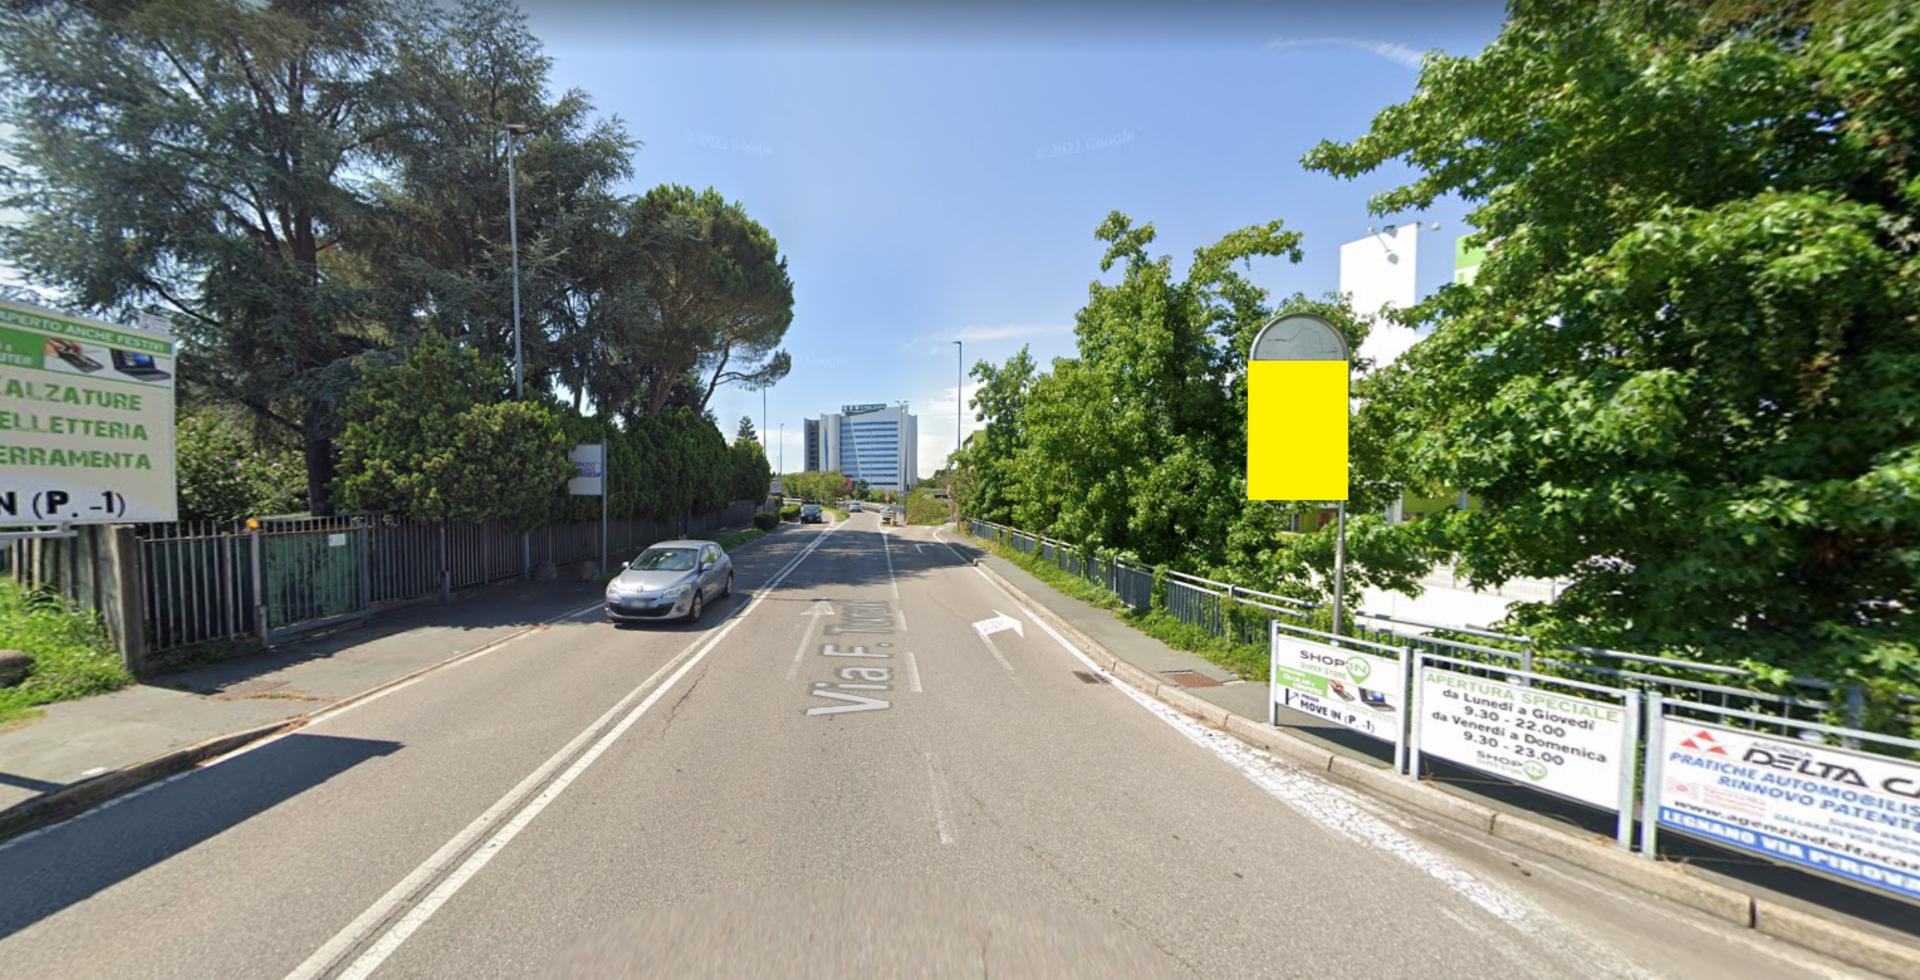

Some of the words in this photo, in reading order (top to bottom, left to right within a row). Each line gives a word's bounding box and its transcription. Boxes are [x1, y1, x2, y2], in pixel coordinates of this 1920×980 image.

[66, 325, 114, 343] ANCHE
[0, 377, 141, 411] ALZATURE
[1300, 700, 1328, 716] MOVE
[1331, 710, 1341, 720] IN
[1426, 673, 1515, 701] APERTURA
[1521, 693, 1619, 724] SPECIALE
[1443, 689, 1459, 699] da
[1518, 707, 1527, 715] a
[1431, 711, 1448, 721] da
[1510, 732, 1519, 740] a
[1524, 733, 1607, 763] Domenica
[1464, 706, 1499, 722] 9.30
[1515, 718, 1566, 738] 22.00
[1464, 731, 1498, 748] 9.30
[1514, 745, 1565, 766] 23.00
[1669, 752, 1759, 780] PRATICHE
[1743, 748, 1869, 788] DELTA
[1718, 775, 1814, 806] RINNOVO
[1760, 836, 1804, 859] VIA
